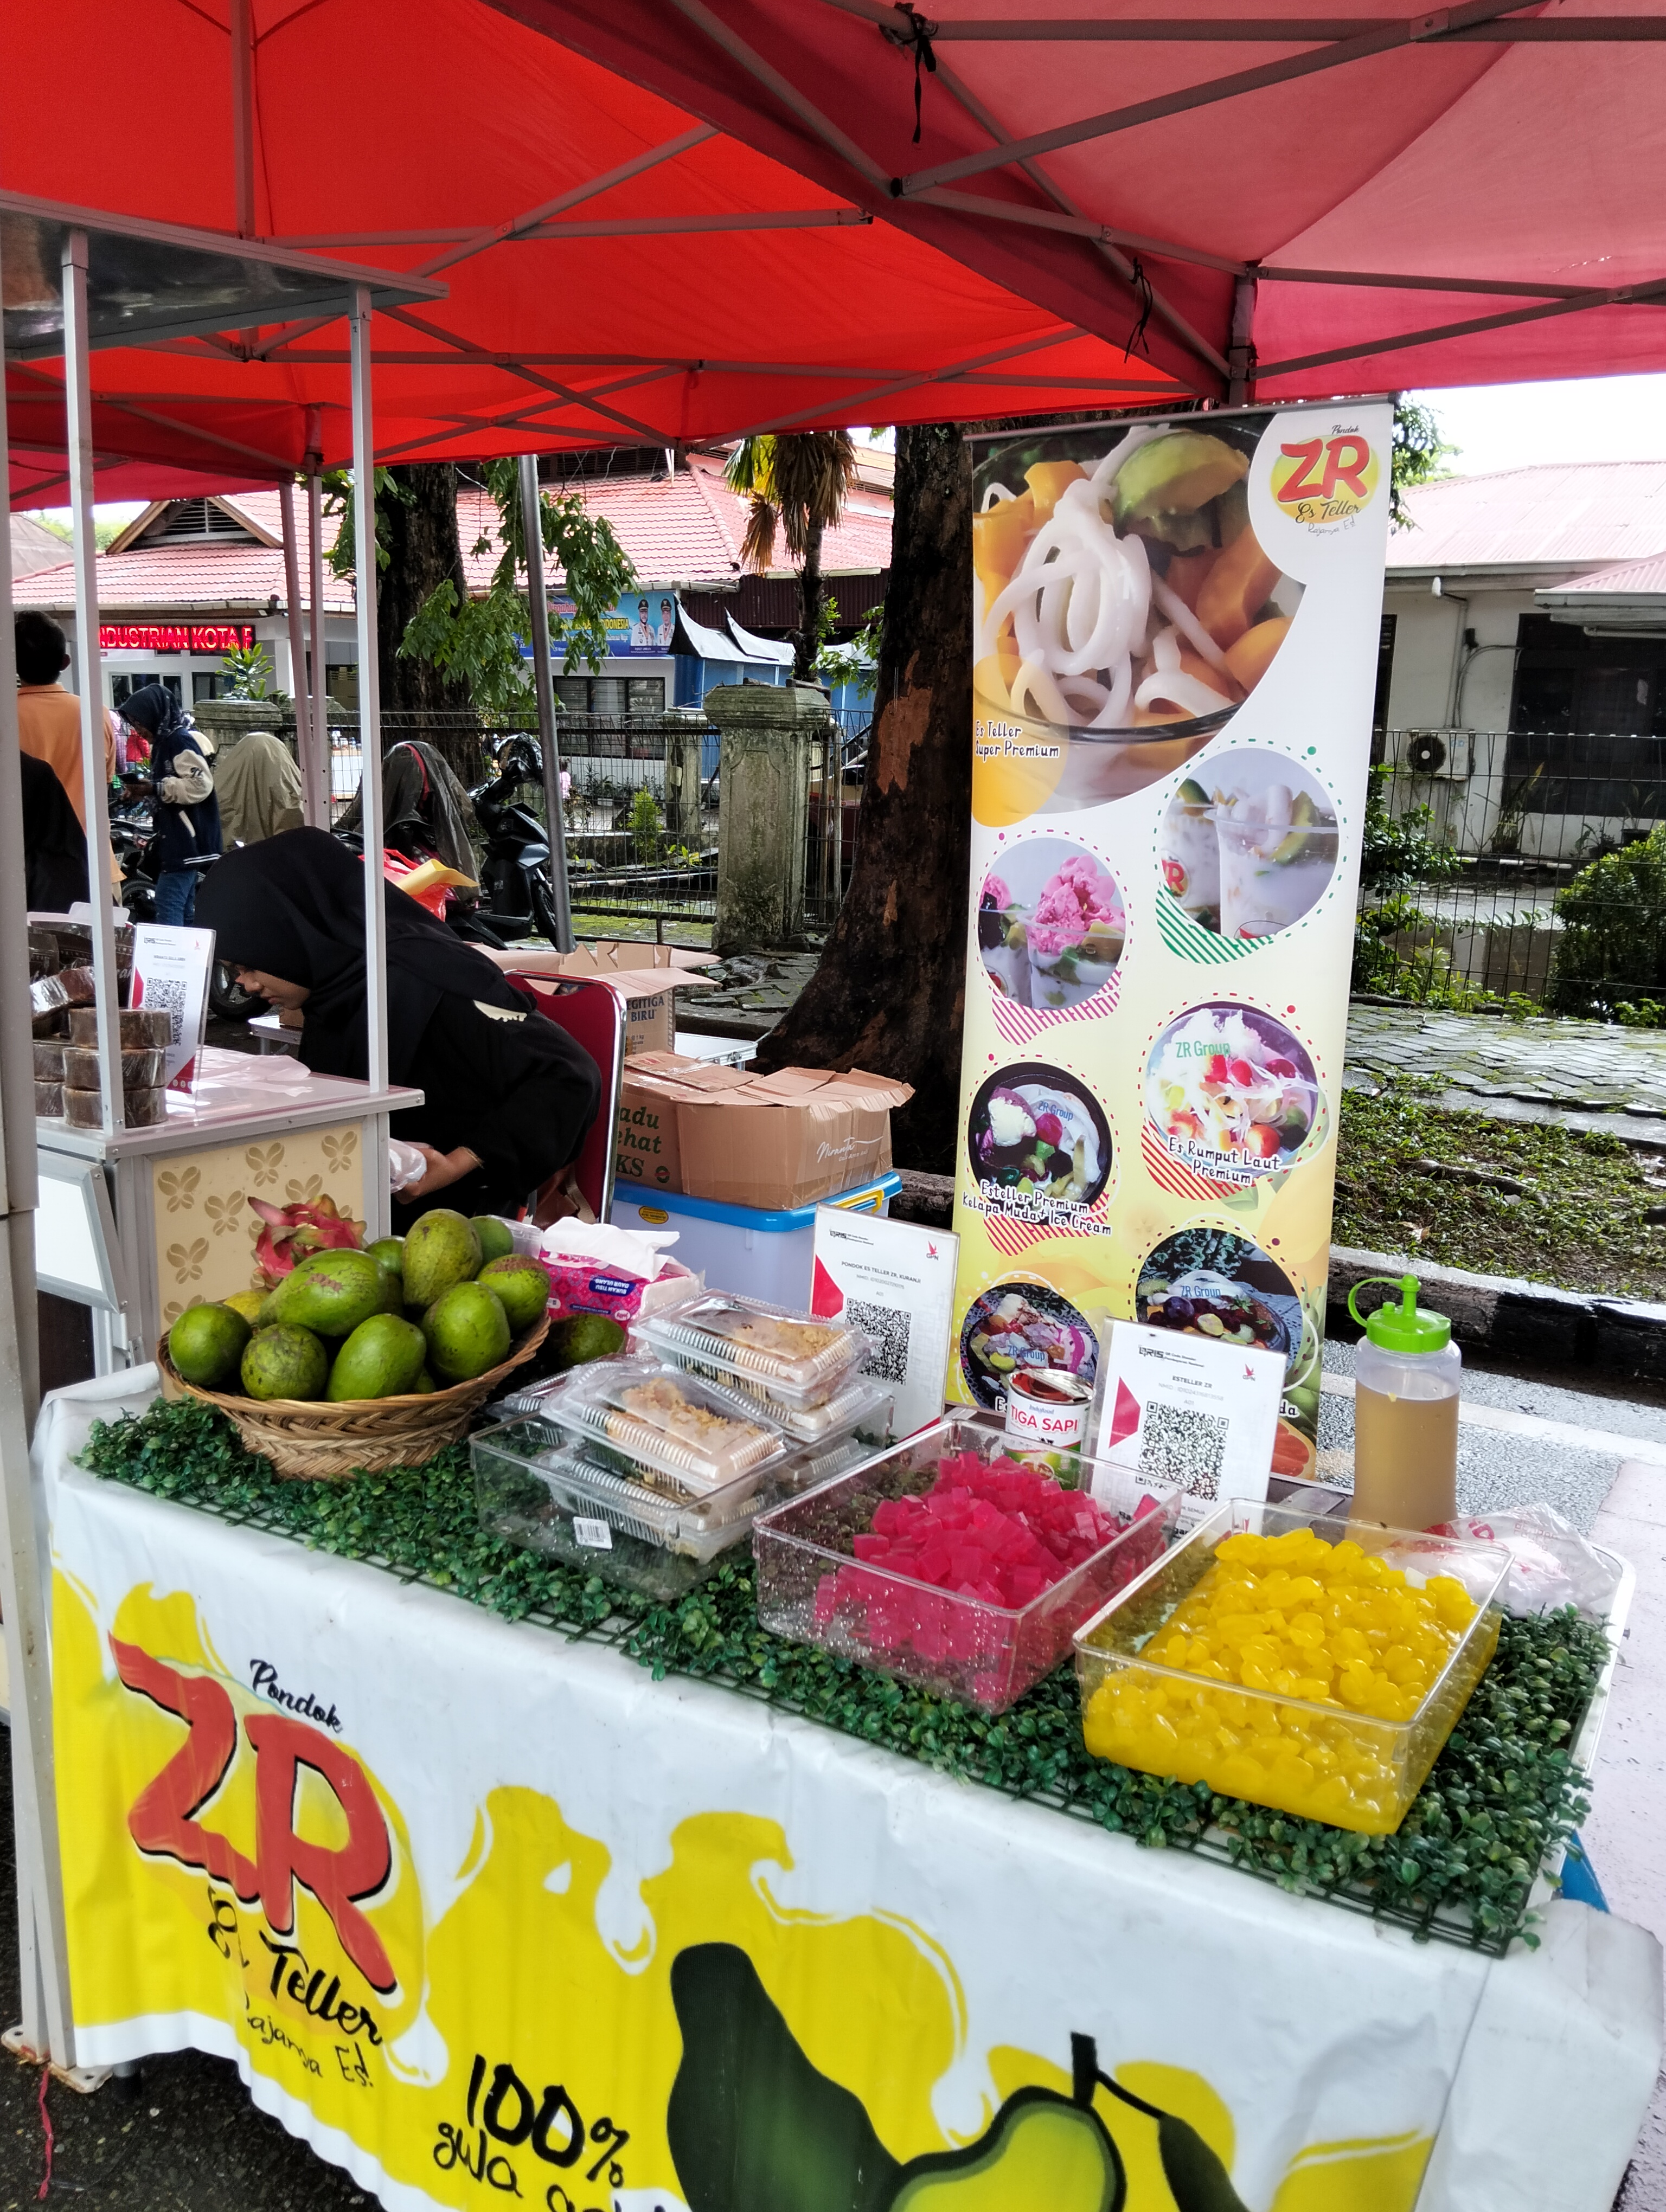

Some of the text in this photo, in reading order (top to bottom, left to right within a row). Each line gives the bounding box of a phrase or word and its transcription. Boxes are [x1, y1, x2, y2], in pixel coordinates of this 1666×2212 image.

[1332, 425, 1360, 435] Pondok
[1277, 435, 1370, 503] ZR
[1295, 500, 1362, 524] Es Teller
[193, 626, 239, 649] KOTA
[976, 721, 1022, 737] Es Teller
[976, 740, 1059, 761] Super Premium
[1161, 859, 1184, 892] R
[626, 996, 664, 1010] EGITIGA
[631, 1009, 655, 1022] BIRU
[1176, 1040, 1231, 1058] ZR Group
[620, 1107, 659, 1129] adu
[1038, 1101, 1074, 1121] ZR Group
[1169, 1137, 1280, 1170] Es Rumput Laut
[1193, 1159, 1251, 1184] Premium
[982, 1182, 1088, 1214] Esteller Premium
[1050, 1210, 1067, 1226] Ice
[1072, 1215, 1111, 1235] Cream
[841, 1261, 863, 1270] PONDOK
[872, 1267, 889, 1276] TELLER
[899, 1274, 921, 1284] KURANJI
[1181, 1285, 1221, 1298] ZR Group
[1008, 1345, 1046, 1362] ZR Group
[1139, 1346, 1164, 1359] QRIS
[1172, 1375, 1203, 1386] ESTELLER
[1011, 1405, 1037, 1428] TIGA
[1042, 1418, 1078, 1432] SAPI
[250, 1658, 343, 1733] Pondok
[107, 1628, 398, 1995] ZR
[259, 1930, 383, 2046] Teller
[466, 2053, 630, 2188] 100%
[433, 2122, 524, 2198] gula
